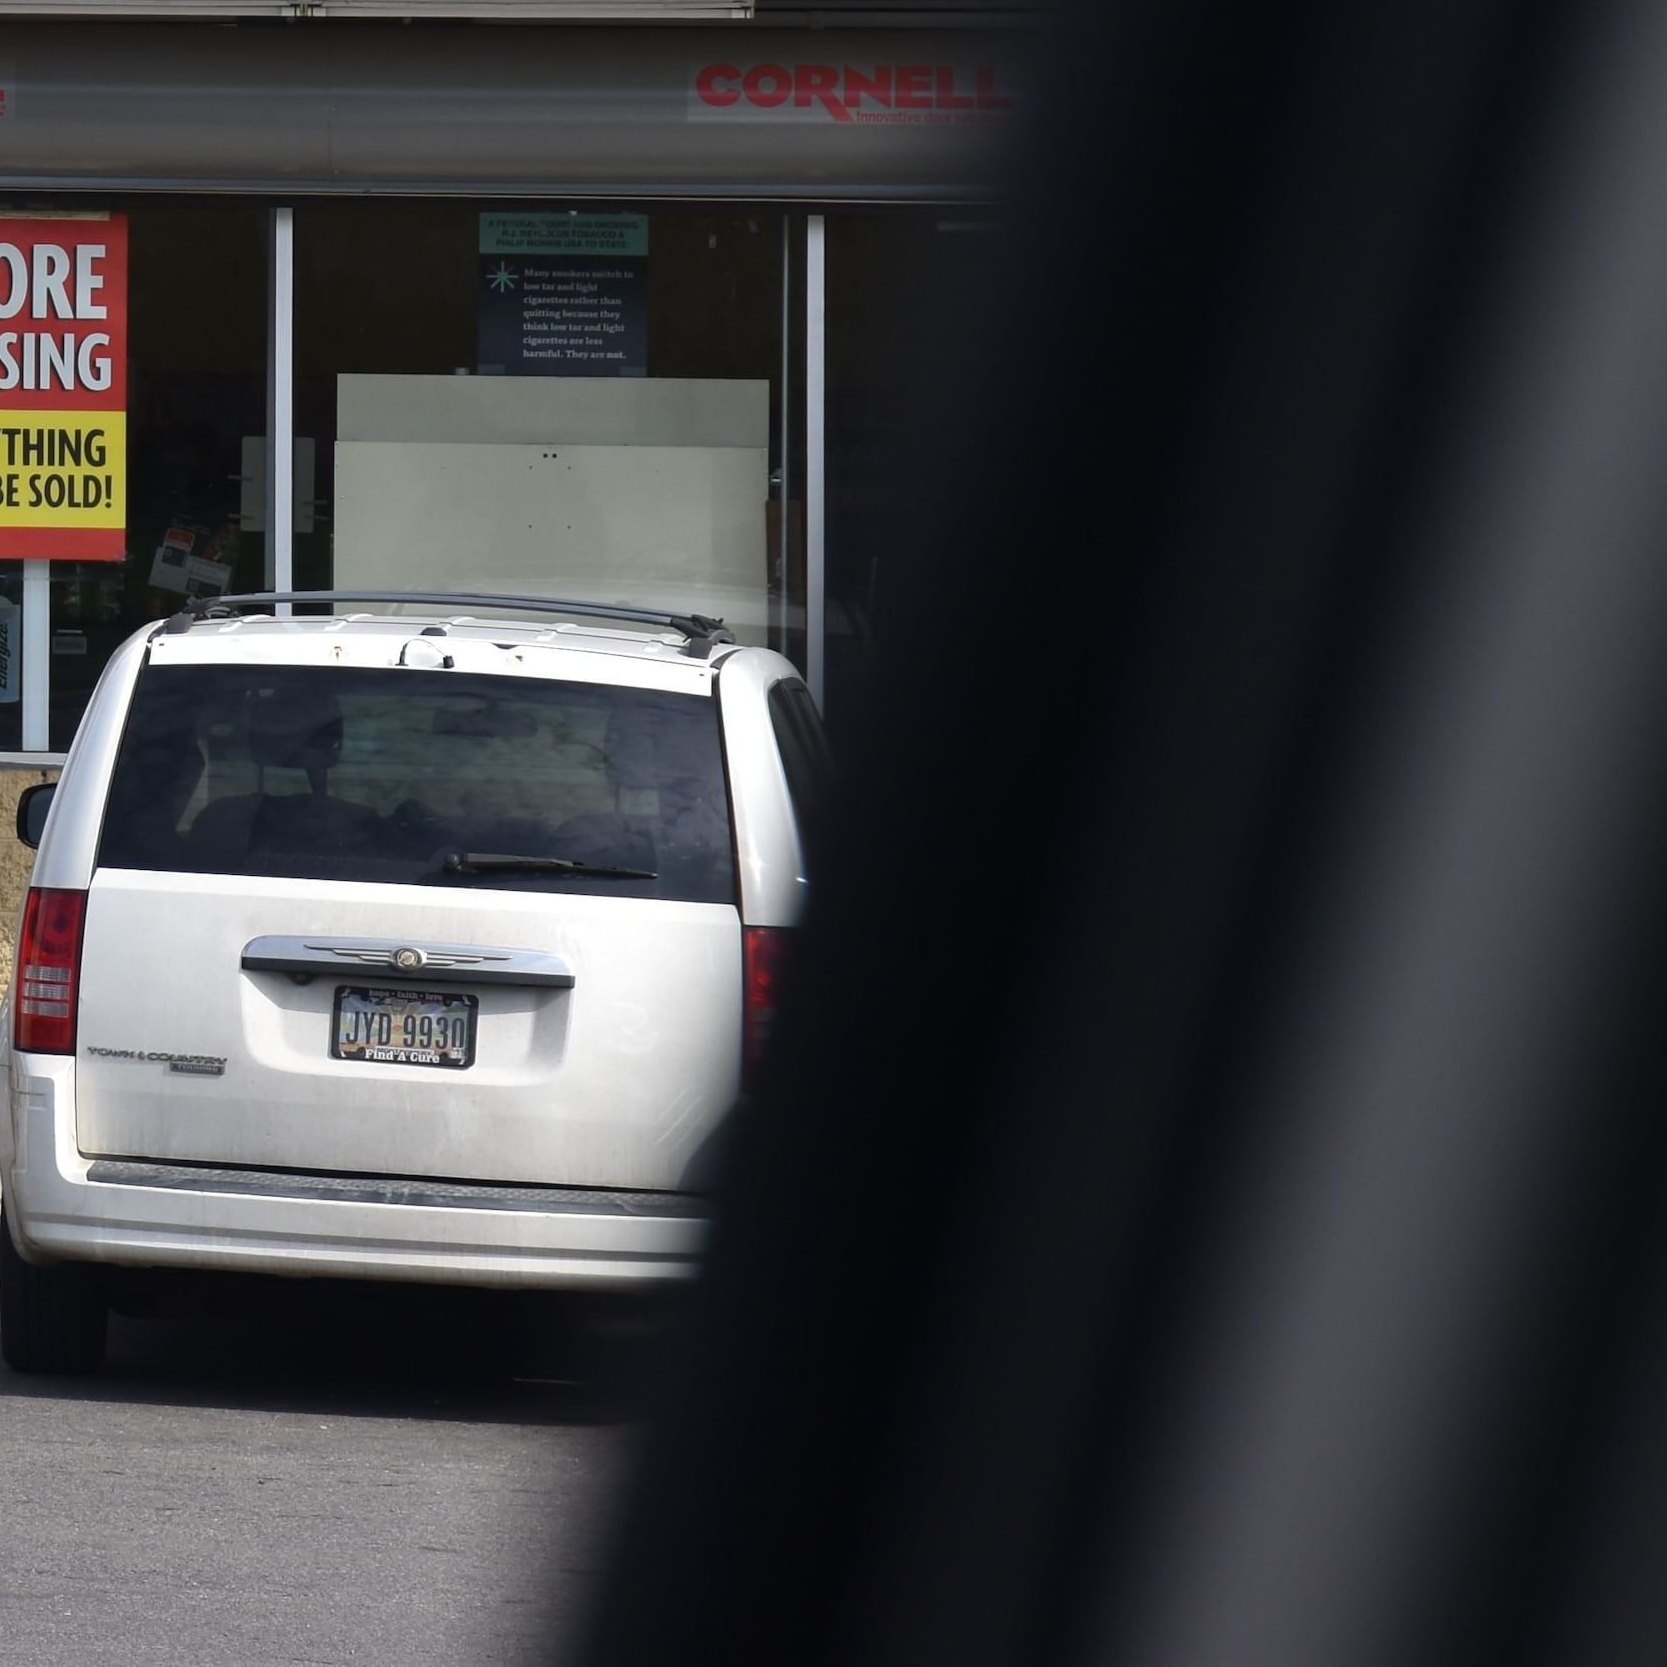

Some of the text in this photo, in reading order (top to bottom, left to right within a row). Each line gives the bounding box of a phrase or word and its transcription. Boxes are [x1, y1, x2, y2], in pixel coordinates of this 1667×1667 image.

[695, 62, 1017, 123] CORNELL
[524, 269, 634, 280] Many smokers switch to
[523, 283, 598, 293] low tar and light
[523, 296, 622, 307] cigarettes rather than
[523, 309, 621, 320] quitting because they
[523, 322, 625, 334] think low tar and light
[523, 336, 603, 347] cigarettes are less
[523, 349, 627, 361] harmful. They are not.
[28, 474, 113, 509] SOLD!
[345, 1010, 465, 1050] JYD 9930
[364, 1048, 395, 1061] Find
[396, 1051, 407, 1062] A
[409, 1051, 441, 1064] Cure
